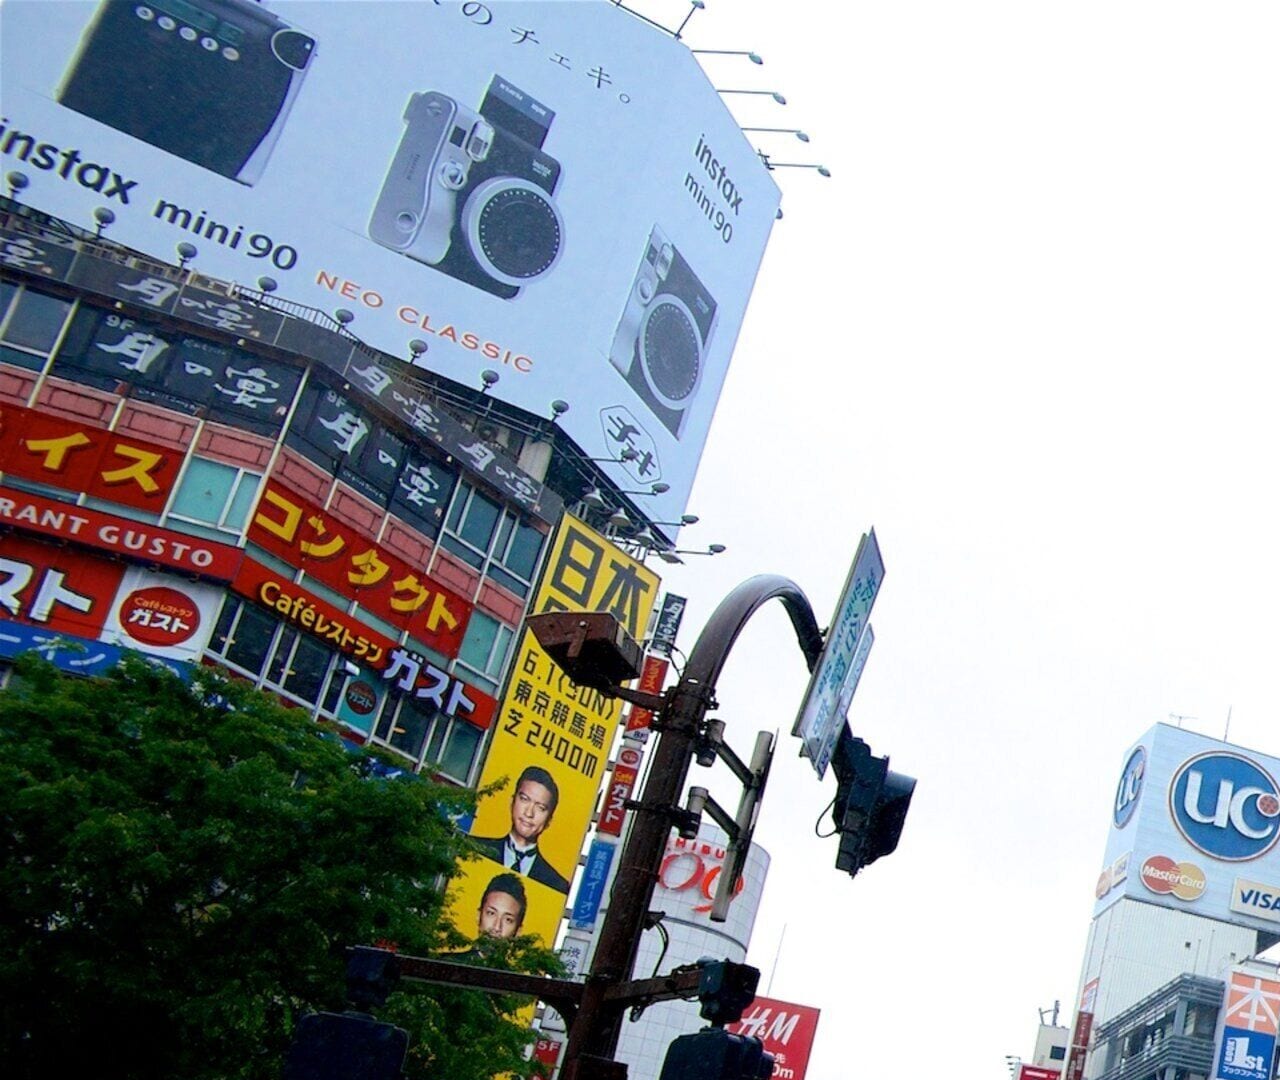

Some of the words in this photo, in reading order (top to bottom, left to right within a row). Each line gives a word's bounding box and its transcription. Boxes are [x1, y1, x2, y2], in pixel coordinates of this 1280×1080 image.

[432, 0, 631, 104] のチェキ。
[694, 133, 744, 215] instax
[684, 172, 733, 244] mini90
[105, 314, 136, 330] 9F
[316, 269, 383, 310] NEO
[397, 304, 535, 374] CLASSIC
[26, 432, 162, 493] イス
[99, 526, 213, 567] GUSTO
[255, 489, 458, 632] コンタクト
[129, 608, 190, 633] ガスト
[383, 649, 476, 716] ガスト
[513, 679, 607, 751] 東京競馬場
[1143, 863, 1206, 891] MasterCard
[737, 1005, 801, 1046] H&M
[1222, 1065, 1267, 1080] ブックファースト
